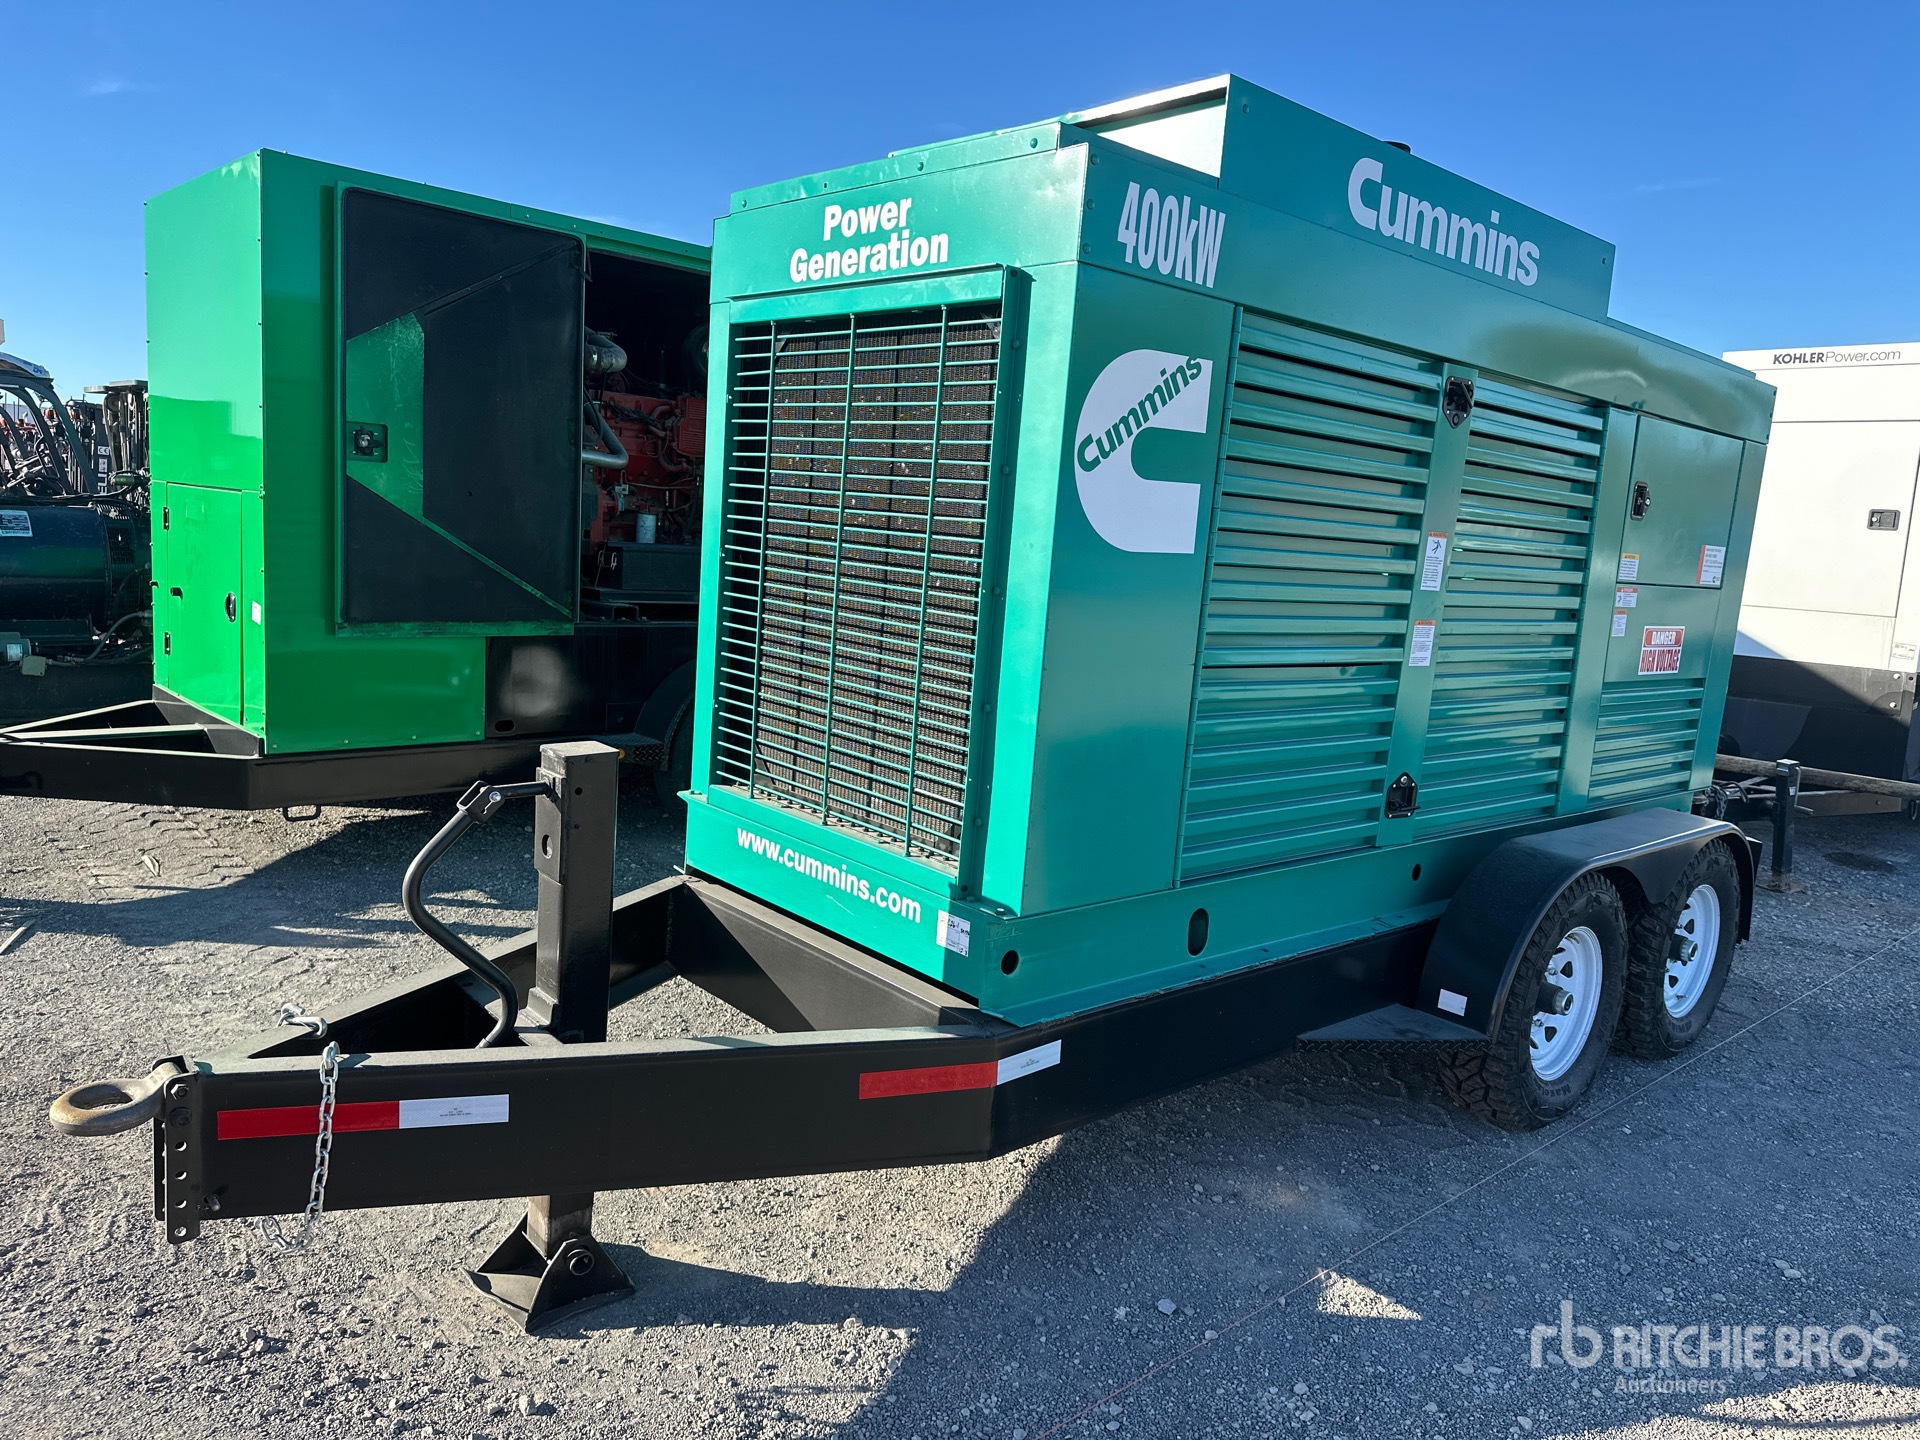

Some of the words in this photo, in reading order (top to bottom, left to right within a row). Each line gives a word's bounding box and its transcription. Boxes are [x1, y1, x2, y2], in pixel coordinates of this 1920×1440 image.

[823, 197, 912, 241] Power
[1117, 181, 1226, 288] 400kW
[1347, 157, 1540, 286] Cummins
[789, 229, 949, 283] Generation
[1772, 350, 1901, 365] KOHLERPower.com
[1077, 356, 1202, 473] Cummins
[1640, 649, 1657, 673] HIGH
[1656, 648, 1681, 672] VOLTAGE
[1651, 631, 1677, 645] DANGER
[736, 827, 921, 924] www.cummins.com
